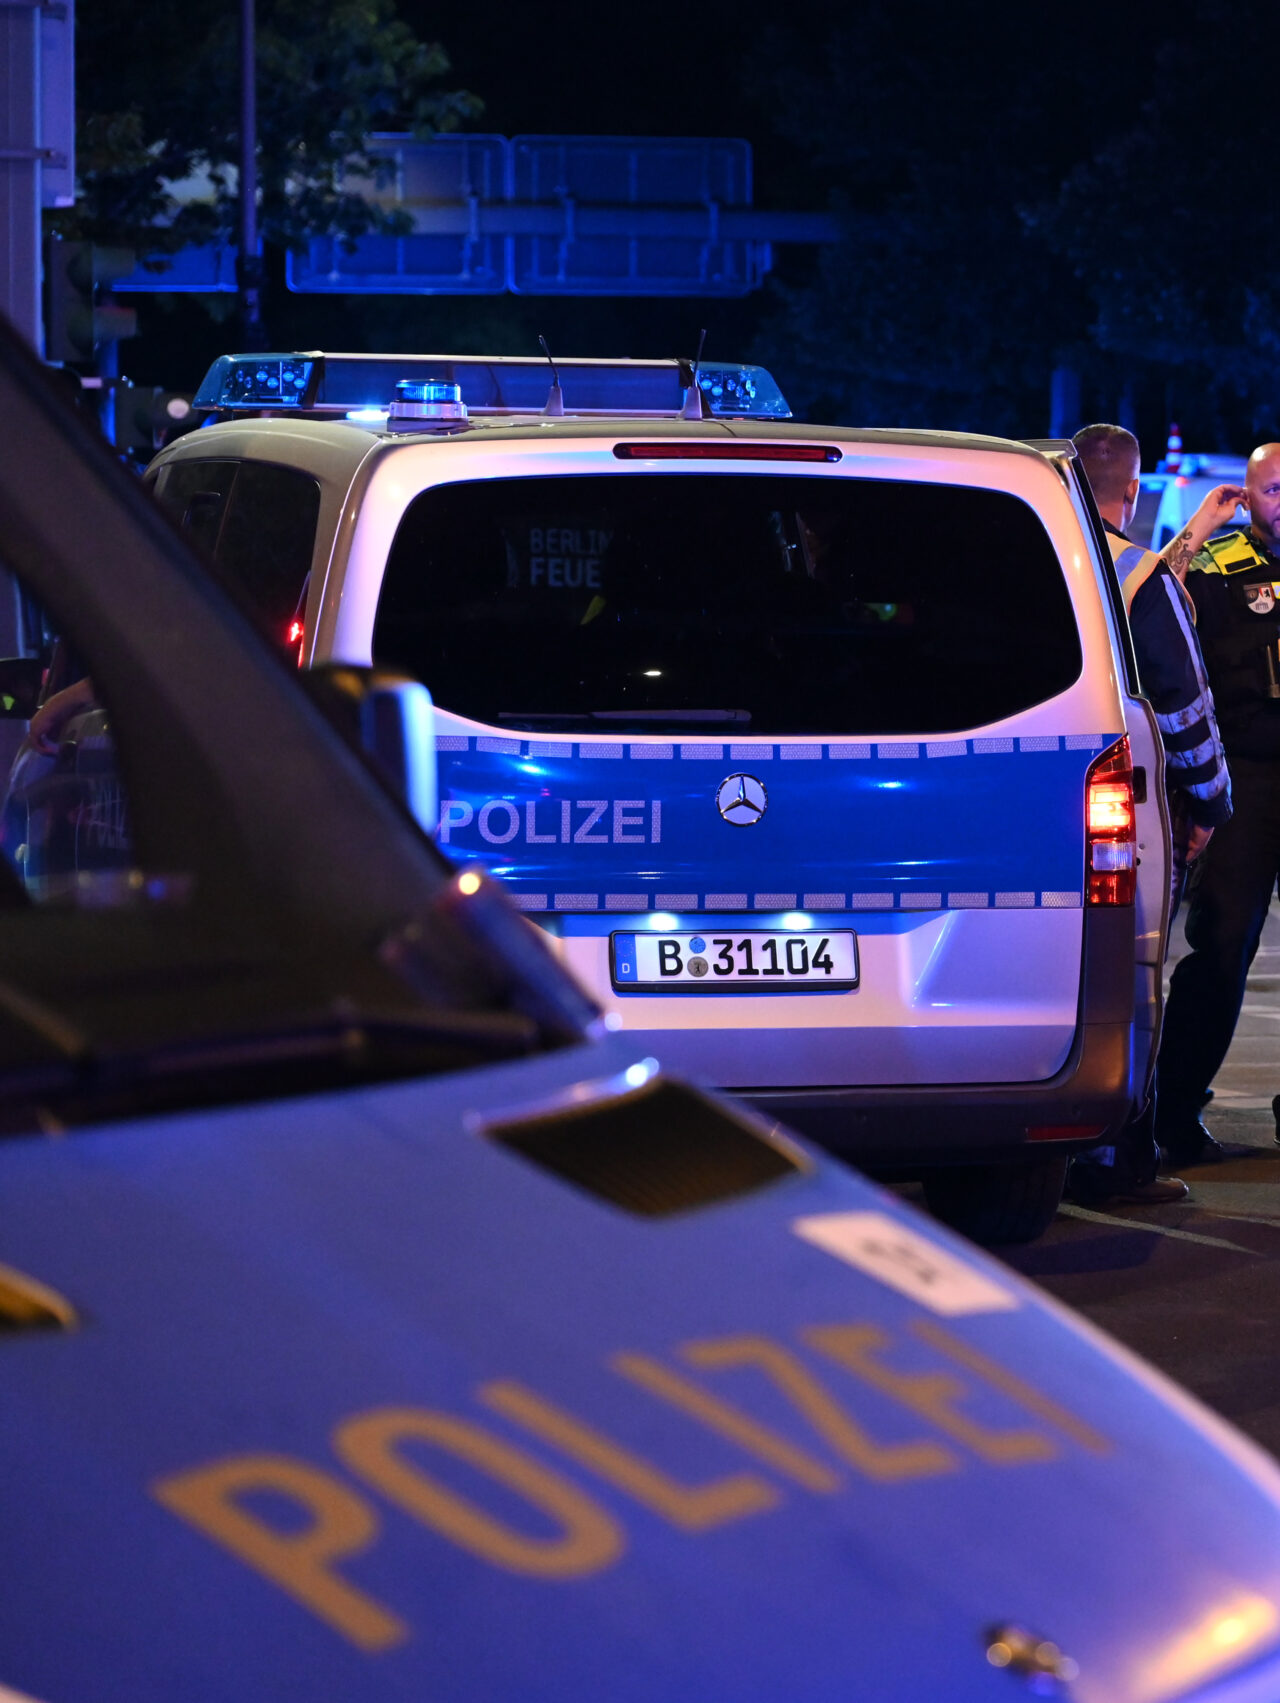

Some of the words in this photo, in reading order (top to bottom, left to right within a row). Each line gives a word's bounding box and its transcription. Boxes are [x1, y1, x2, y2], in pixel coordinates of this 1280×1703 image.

[441, 800, 661, 843] POLIZEI
[622, 963, 630, 973] D
[658, 940, 683, 976] B
[713, 939, 833, 976] 31104
[152, 1317, 1112, 1653] POLIZEI
